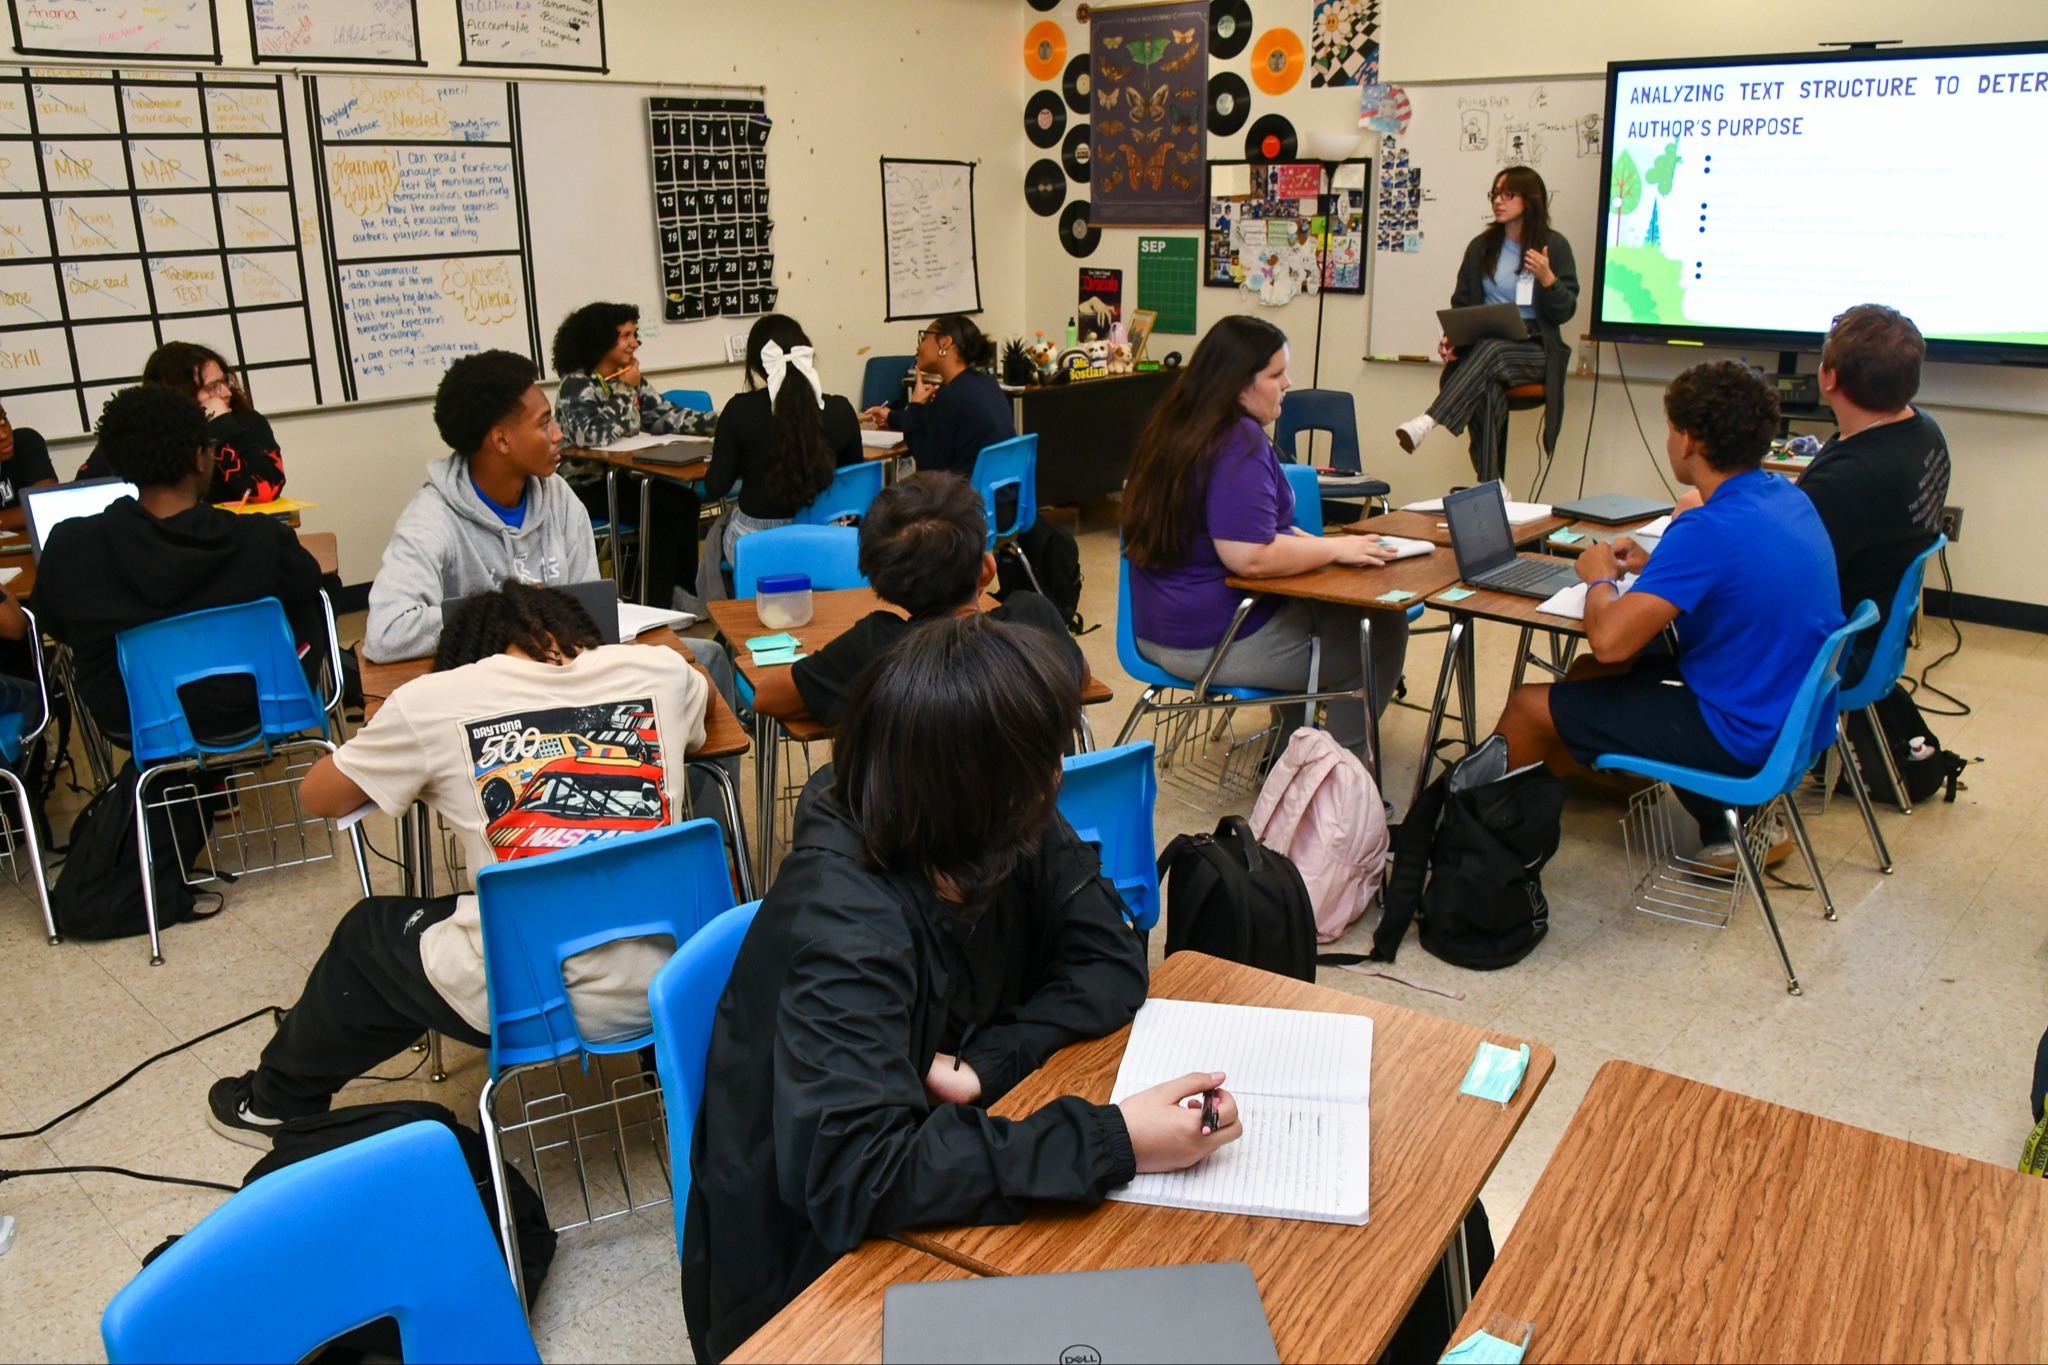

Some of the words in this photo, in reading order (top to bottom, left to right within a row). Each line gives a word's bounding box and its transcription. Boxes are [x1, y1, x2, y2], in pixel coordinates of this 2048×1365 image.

[28, 4, 79, 20] Ariana
[467, 19, 530, 33] Accountable
[469, 33, 490, 46] Fair
[437, 84, 468, 100] pencil
[1630, 84, 1725, 104] ANALYZING
[1740, 81, 1785, 101] TEXT
[1800, 77, 1918, 99] STRUCTURE
[1935, 75, 1960, 95] TO
[1978, 72, 2048, 94] DETER
[392, 111, 440, 128] Needed
[336, 119, 380, 139] notebook
[662, 124, 667, 134] 1
[681, 124, 687, 135] 2
[701, 125, 707, 135] 3
[721, 126, 727, 136] 4
[739, 126, 744, 136] 5
[760, 131, 766, 141] 6
[1628, 119, 1712, 139] AUTHOR'S
[1718, 117, 1804, 137] PURPOSE
[408, 152, 427, 165] can
[434, 150, 456, 164] read
[663, 161, 668, 170] 7
[683, 160, 689, 170] 8
[703, 160, 709, 169] 9
[718, 161, 729, 170] 10
[741, 160, 748, 169] 11
[756, 160, 765, 169] 12
[54, 156, 93, 181] MAP
[141, 158, 183, 183] MAP
[332, 151, 392, 187] Learning
[399, 168, 442, 182] analyze
[449, 167, 456, 175] a
[462, 163, 511, 176] nonfiction
[401, 179, 420, 191] text
[425, 176, 437, 191] by
[442, 176, 485, 191] monitoring
[489, 176, 504, 188] my
[51, 200, 64, 216] 17
[387, 204, 406, 216] how
[410, 202, 425, 214] the
[429, 201, 456, 211] author
[662, 197, 674, 207] 13
[684, 196, 695, 206] 14
[704, 194, 715, 204] 15
[721, 195, 733, 205] 16
[743, 194, 751, 204] 17
[760, 194, 767, 204] 18
[361, 217, 376, 231] the
[403, 216, 410, 227] &
[413, 215, 459, 231] evaluating
[464, 213, 480, 225] the
[393, 229, 430, 243] purpose
[434, 227, 445, 237] for
[450, 229, 478, 245] writing
[668, 232, 678, 242] 19
[687, 230, 697, 240] 20
[707, 229, 717, 239] 21
[724, 229, 735, 239] 22
[745, 228, 753, 238] 23
[1141, 240, 1166, 253] SEP
[63, 263, 80, 278] 24
[229, 257, 246, 269] 26
[669, 269, 680, 278] 25
[690, 265, 700, 275] 26
[709, 263, 718, 272] 27
[725, 262, 737, 272] 28
[747, 262, 757, 271] 29
[763, 260, 771, 270] 30
[104, 273, 129, 289] read
[356, 268, 370, 278] can
[408, 276, 420, 285] the
[452, 260, 505, 287] Success
[172, 285, 209, 302] TEST!
[469, 289, 511, 312] Criteria
[358, 298, 371, 307] can
[677, 305, 685, 315] 31
[726, 296, 737, 305] 34
[749, 294, 759, 304] 35
[767, 294, 776, 304] 36
[353, 310, 375, 323] that
[380, 307, 414, 319] explain
[418, 305, 434, 315] the
[368, 350, 384, 359] can
[472, 719, 523, 739] DAYTONA
[479, 727, 541, 769] 500
[520, 827, 637, 848] NASCA
[1064, 1354, 1098, 1364] DELL
